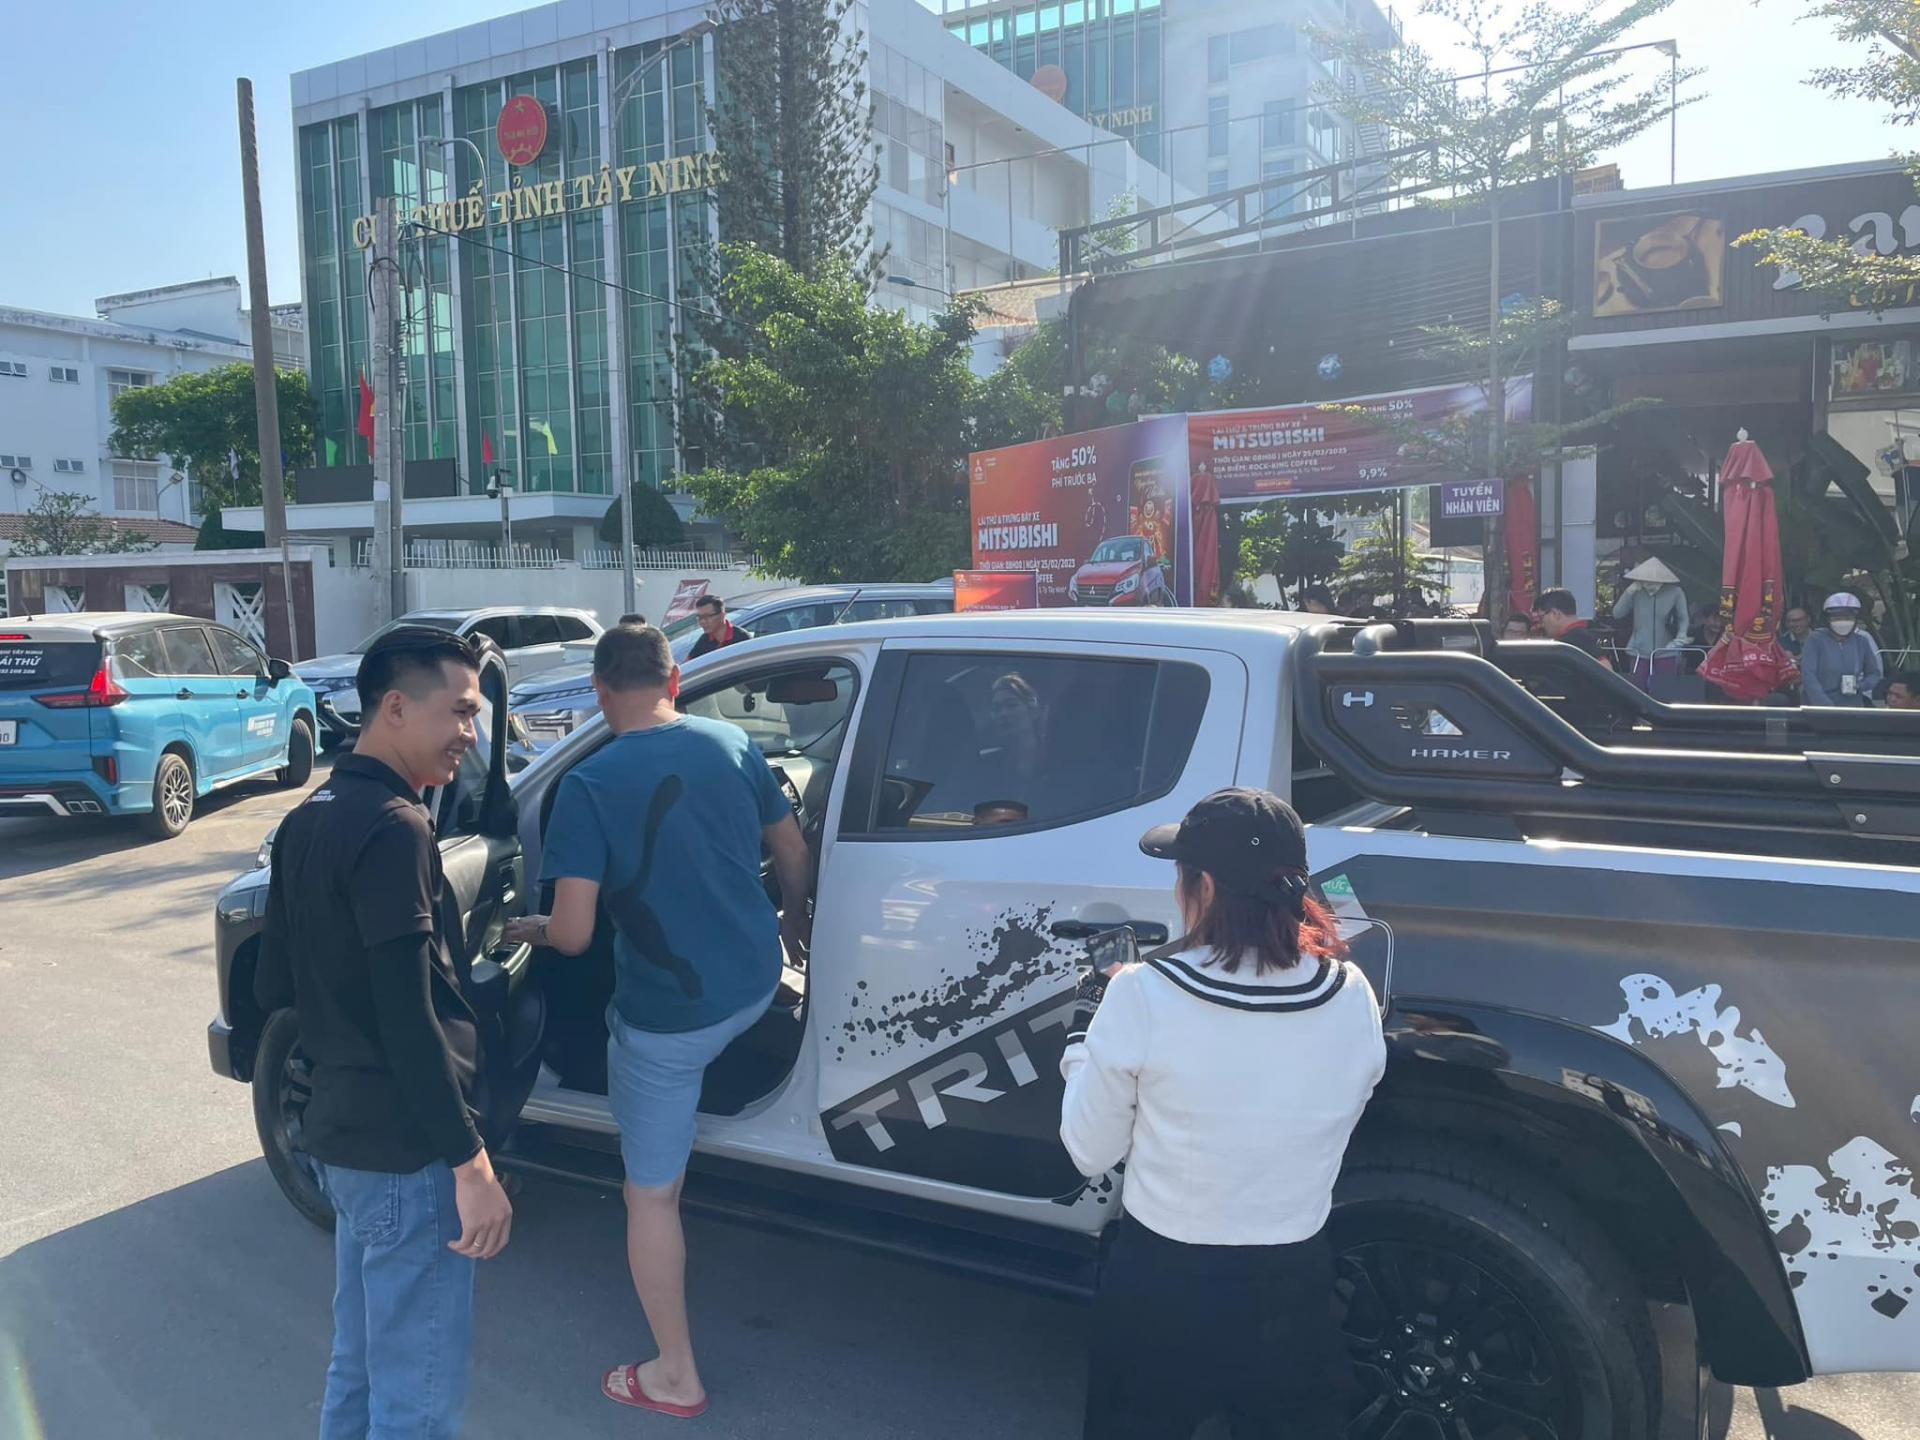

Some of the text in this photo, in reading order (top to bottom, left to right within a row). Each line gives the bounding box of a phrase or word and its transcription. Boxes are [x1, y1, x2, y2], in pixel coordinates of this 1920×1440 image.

[1112, 105, 1153, 128] NINH
[412, 178, 485, 238] THUẾ
[495, 175, 566, 224] TỈNH
[576, 161, 637, 208] TÂY
[1388, 399, 1413, 411] 50%
[1213, 427, 1325, 450] MITSUBISHI
[1071, 445, 1097, 467] 50%
[1359, 466, 1388, 480] 9,9%
[1452, 482, 1493, 497] TUYỂN
[1446, 497, 1500, 515] NHÂN VIÊN
[978, 523, 1058, 550] MITSUBISHI
[15, 655, 42, 666] THỬ
[1411, 748, 1512, 760] HAMER
